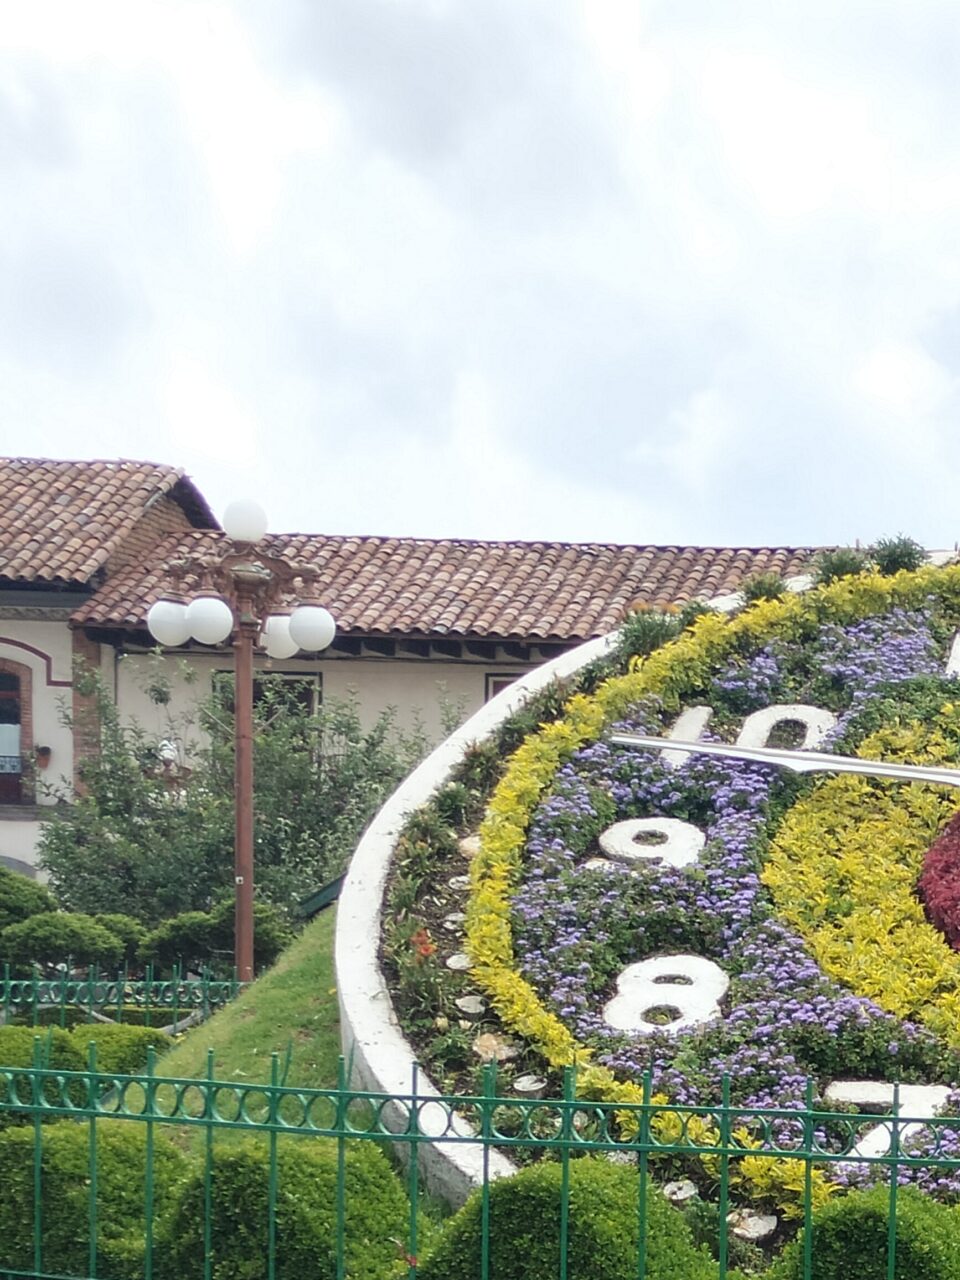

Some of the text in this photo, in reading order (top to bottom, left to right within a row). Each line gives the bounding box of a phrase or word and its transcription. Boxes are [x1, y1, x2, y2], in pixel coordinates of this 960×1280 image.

[660, 705, 836, 768] 10
[582, 817, 706, 870] 9
[603, 955, 730, 1035] 8
[825, 1081, 955, 1160] 7
